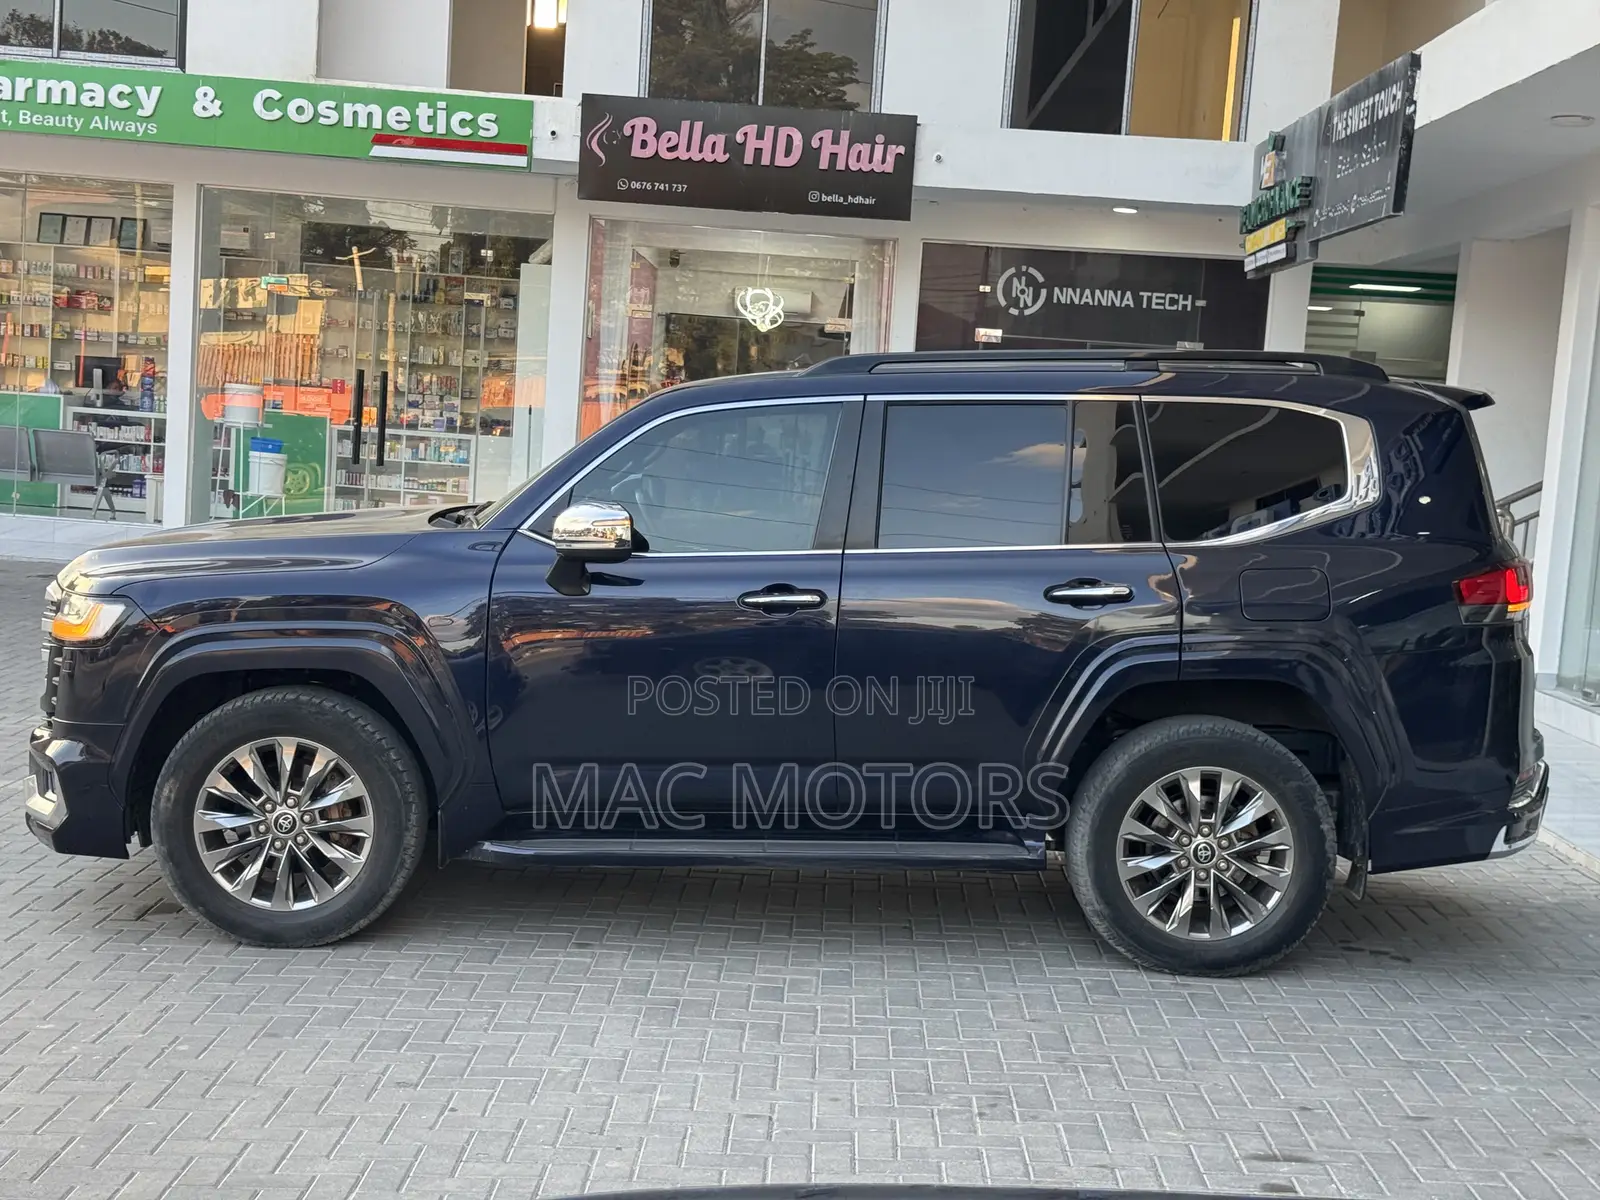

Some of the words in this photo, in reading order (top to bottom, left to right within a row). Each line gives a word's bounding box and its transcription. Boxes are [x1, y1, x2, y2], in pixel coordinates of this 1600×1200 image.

[19, 110, 84, 132] Beauty
[90, 115, 157, 137] Always
[192, 86, 223, 118] &
[252, 88, 499, 138] Cosmetics
[1332, 110, 1347, 143] THE
[1347, 96, 1373, 136] SWEET
[1373, 81, 1404, 123] TOUCH
[623, 116, 730, 163] Bella
[735, 124, 803, 168] HD
[811, 129, 906, 174] Hair
[630, 180, 652, 191] 0676
[654, 182, 669, 192] 741
[671, 183, 688, 193] 737
[821, 193, 876, 206] bella_hdhair
[1052, 287, 1135, 309] NNANNA
[1139, 291, 1193, 312] TECH
